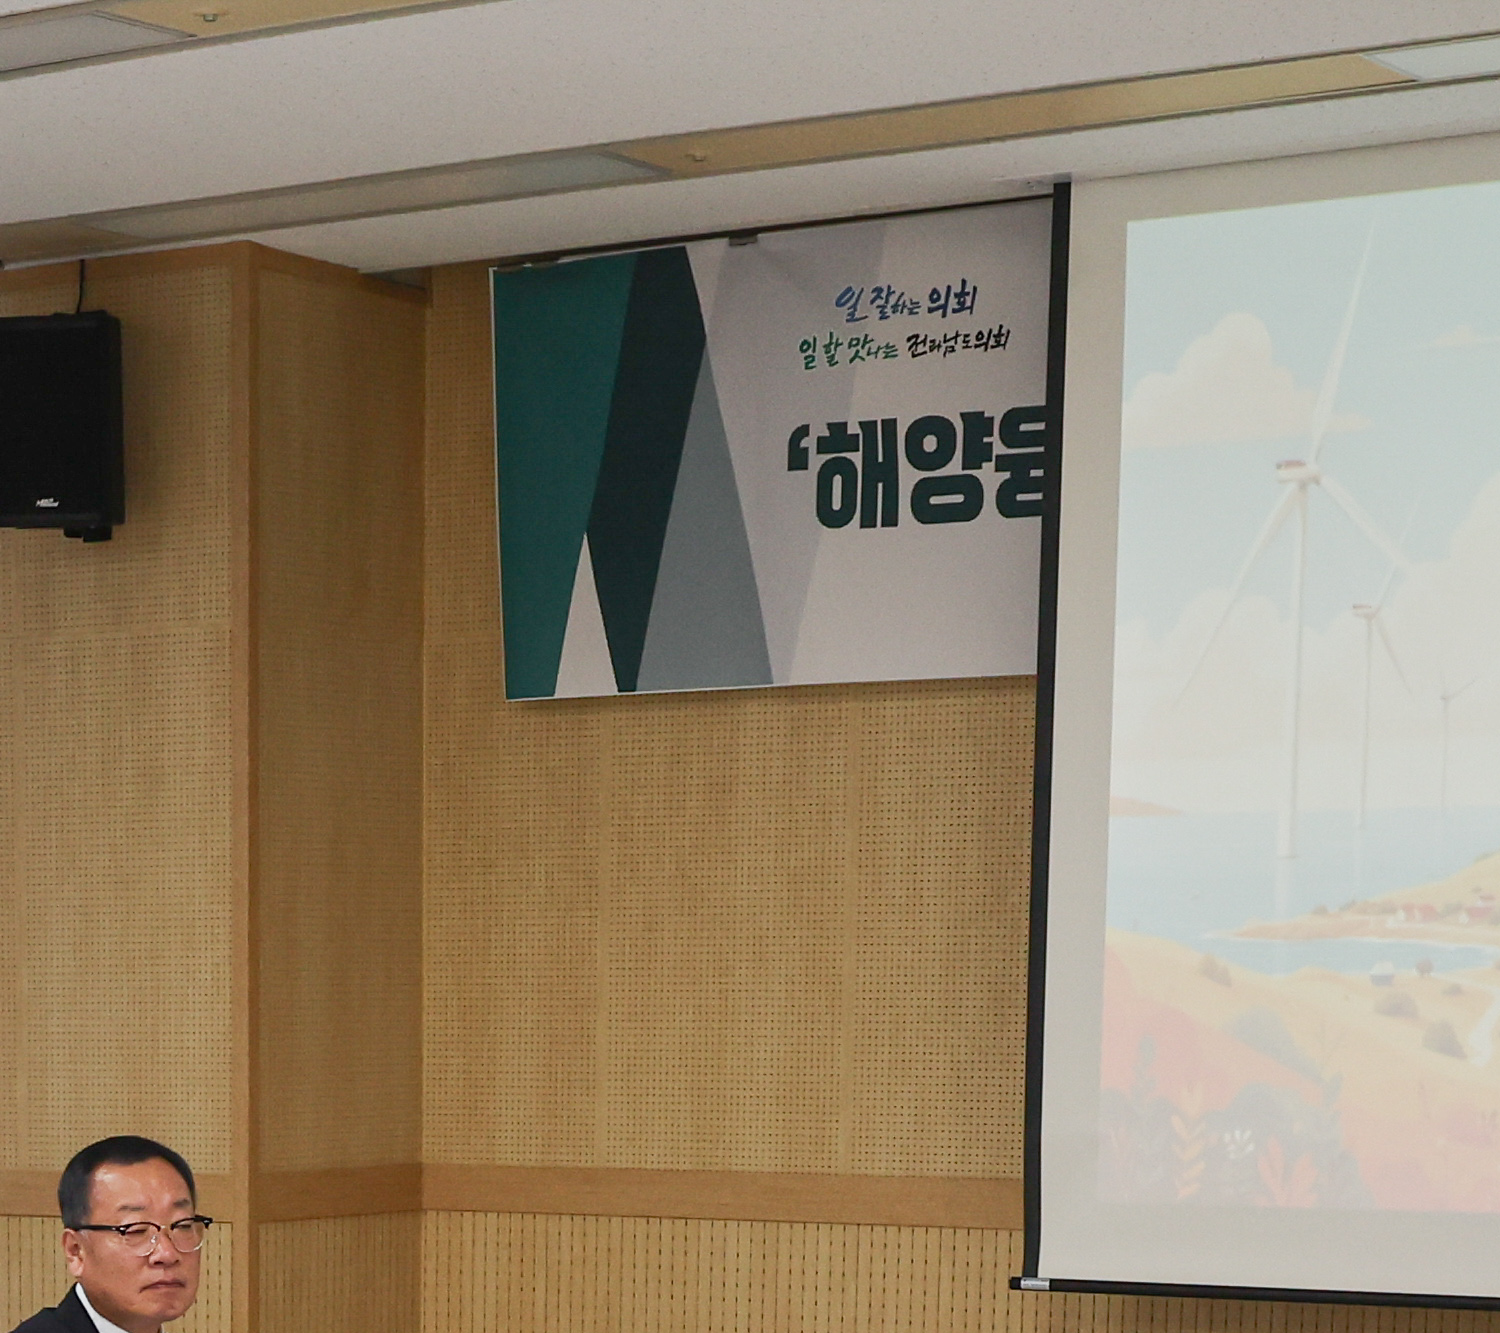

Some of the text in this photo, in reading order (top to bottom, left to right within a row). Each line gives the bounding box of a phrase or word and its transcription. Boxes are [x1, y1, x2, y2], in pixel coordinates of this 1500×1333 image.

[835, 278, 978, 322] 일 잘하는 의회
[848, 334, 899, 364] 맛나는
[906, 324, 1011, 358] 전라남도의회
